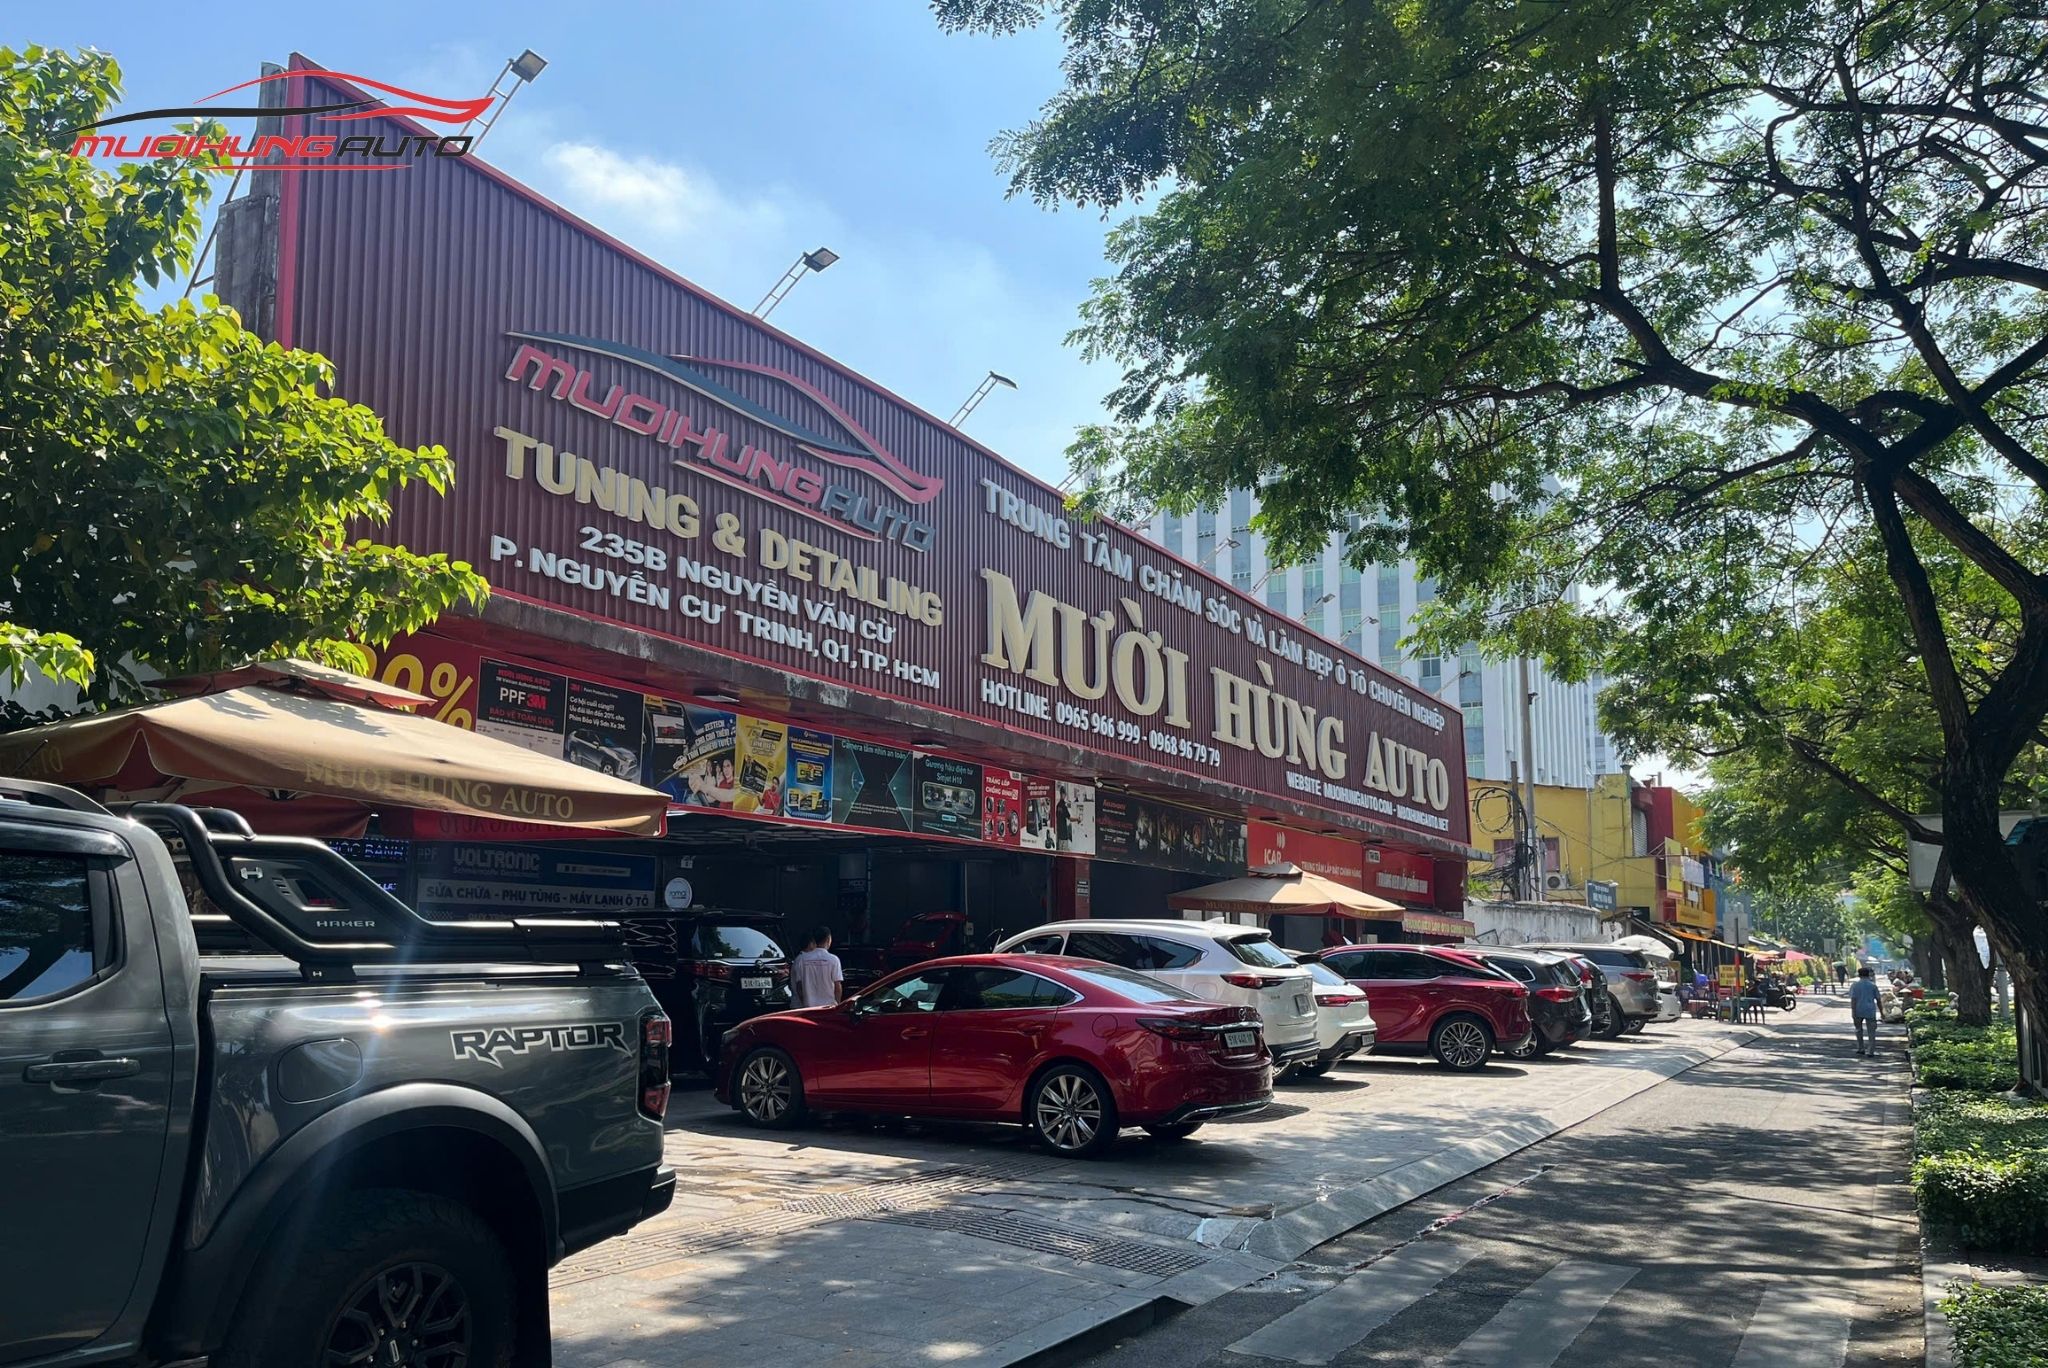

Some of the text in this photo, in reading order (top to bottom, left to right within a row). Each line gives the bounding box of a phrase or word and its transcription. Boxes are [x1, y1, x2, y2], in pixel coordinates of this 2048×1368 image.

[494, 426, 943, 627] TUNING & DETAILING
[490, 535, 523, 568] P.
[529, 547, 669, 611] NGUYỄN
[680, 594, 727, 624] CƯ
[579, 526, 667, 571] 235B
[678, 556, 798, 615] NGUYỄN
[803, 598, 855, 634] VĂN
[980, 477, 1445, 736] TRUNG TÂM CHĂM SÓC VÀ LÀM ĐẸP Ô TÔ CHUYÊN NGHIỆP
[499, 687, 548, 710] PPF 3M
[980, 567, 1450, 812] MƯỜI HÙNG AUTO
[1055, 701, 1090, 731] 0965
[1091, 712, 1115, 738] 966
[1117, 720, 1141, 745] 999
[1149, 729, 1178, 756] 0968
[501, 786, 575, 819] AUTO
[453, 847, 541, 871] VOLTRONIC
[1264, 848, 1282, 865] ICAR
[427, 882, 454, 899] SỬA
[456, 884, 492, 900] CHỮA
[569, 889, 593, 905] MÁY
[595, 892, 624, 908] LẠNH
[316, 920, 376, 928] HAMER
[449, 1021, 635, 1069] RAPTOR
